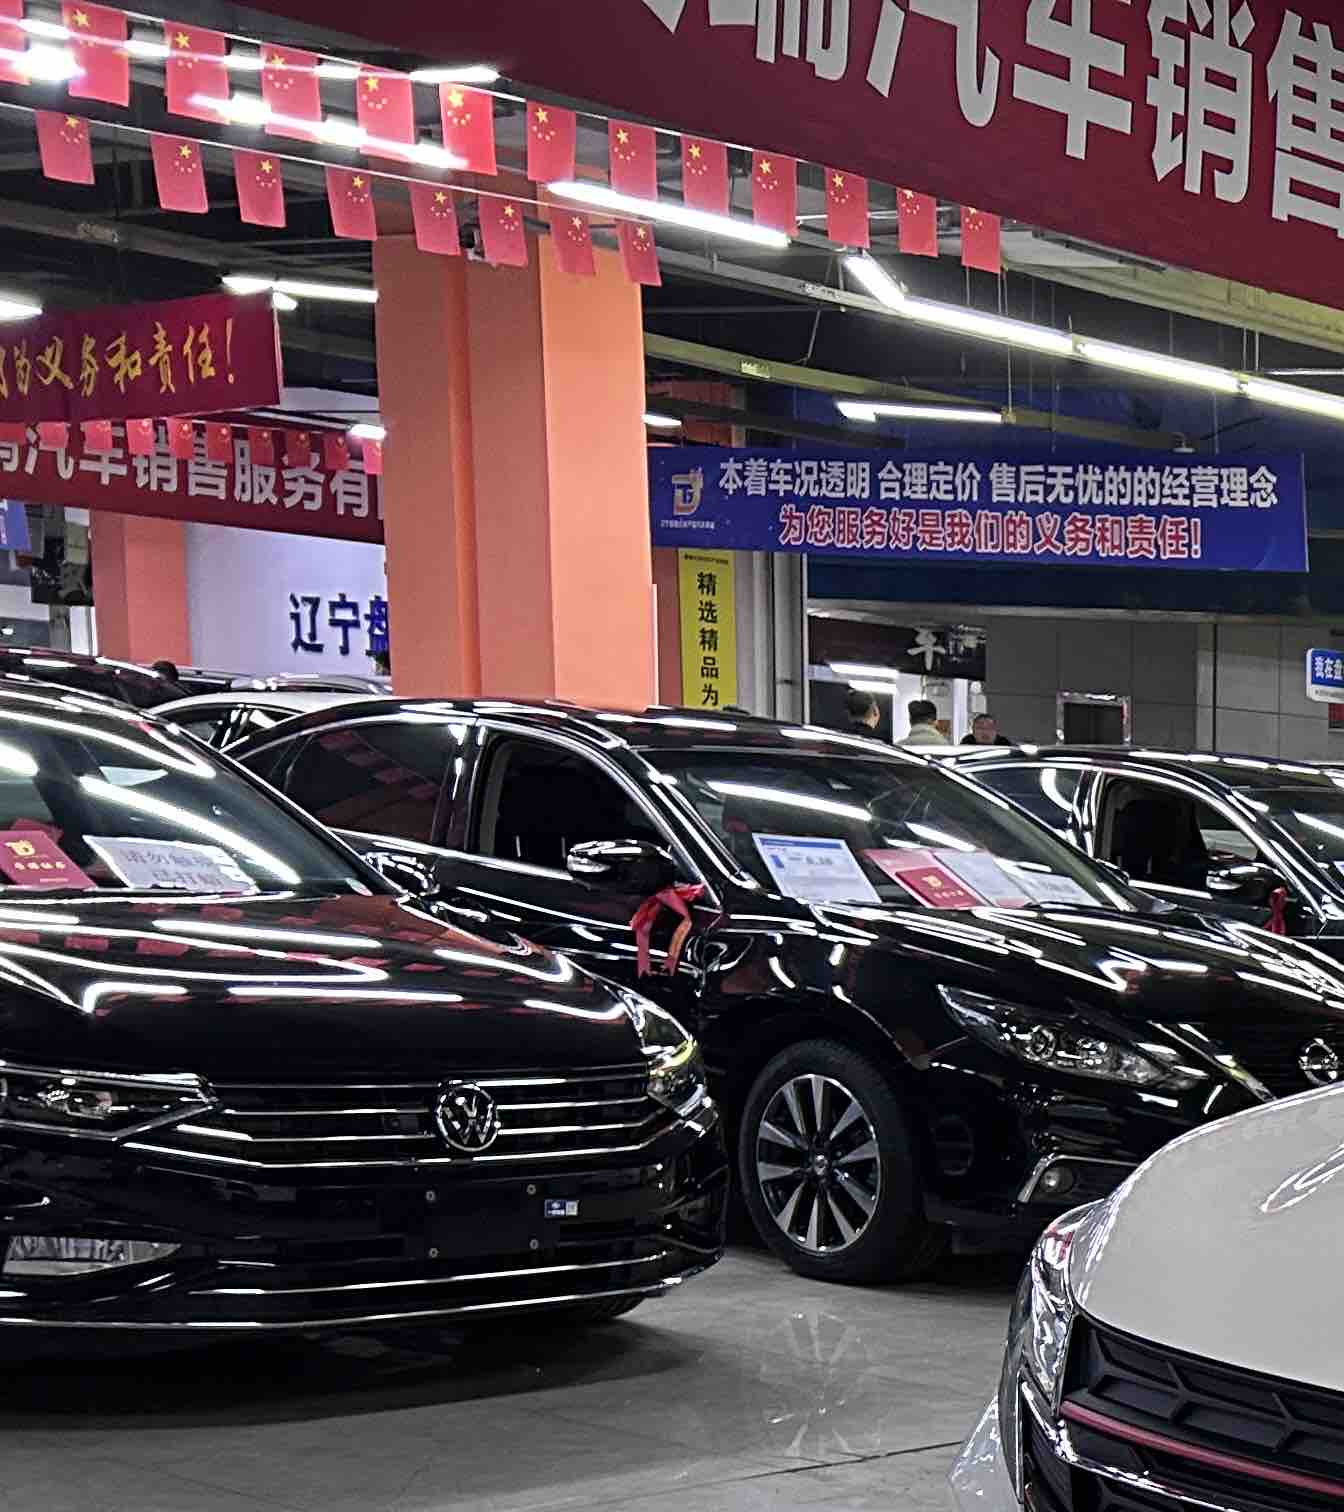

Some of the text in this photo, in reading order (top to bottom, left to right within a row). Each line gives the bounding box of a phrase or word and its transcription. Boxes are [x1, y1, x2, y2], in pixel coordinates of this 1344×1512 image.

[718, 458, 1279, 508] 本着车况透明 合理定价 售后无忧的的经营理念
[779, 503, 1202, 560] 为您服务好是我们的义务和责任！
